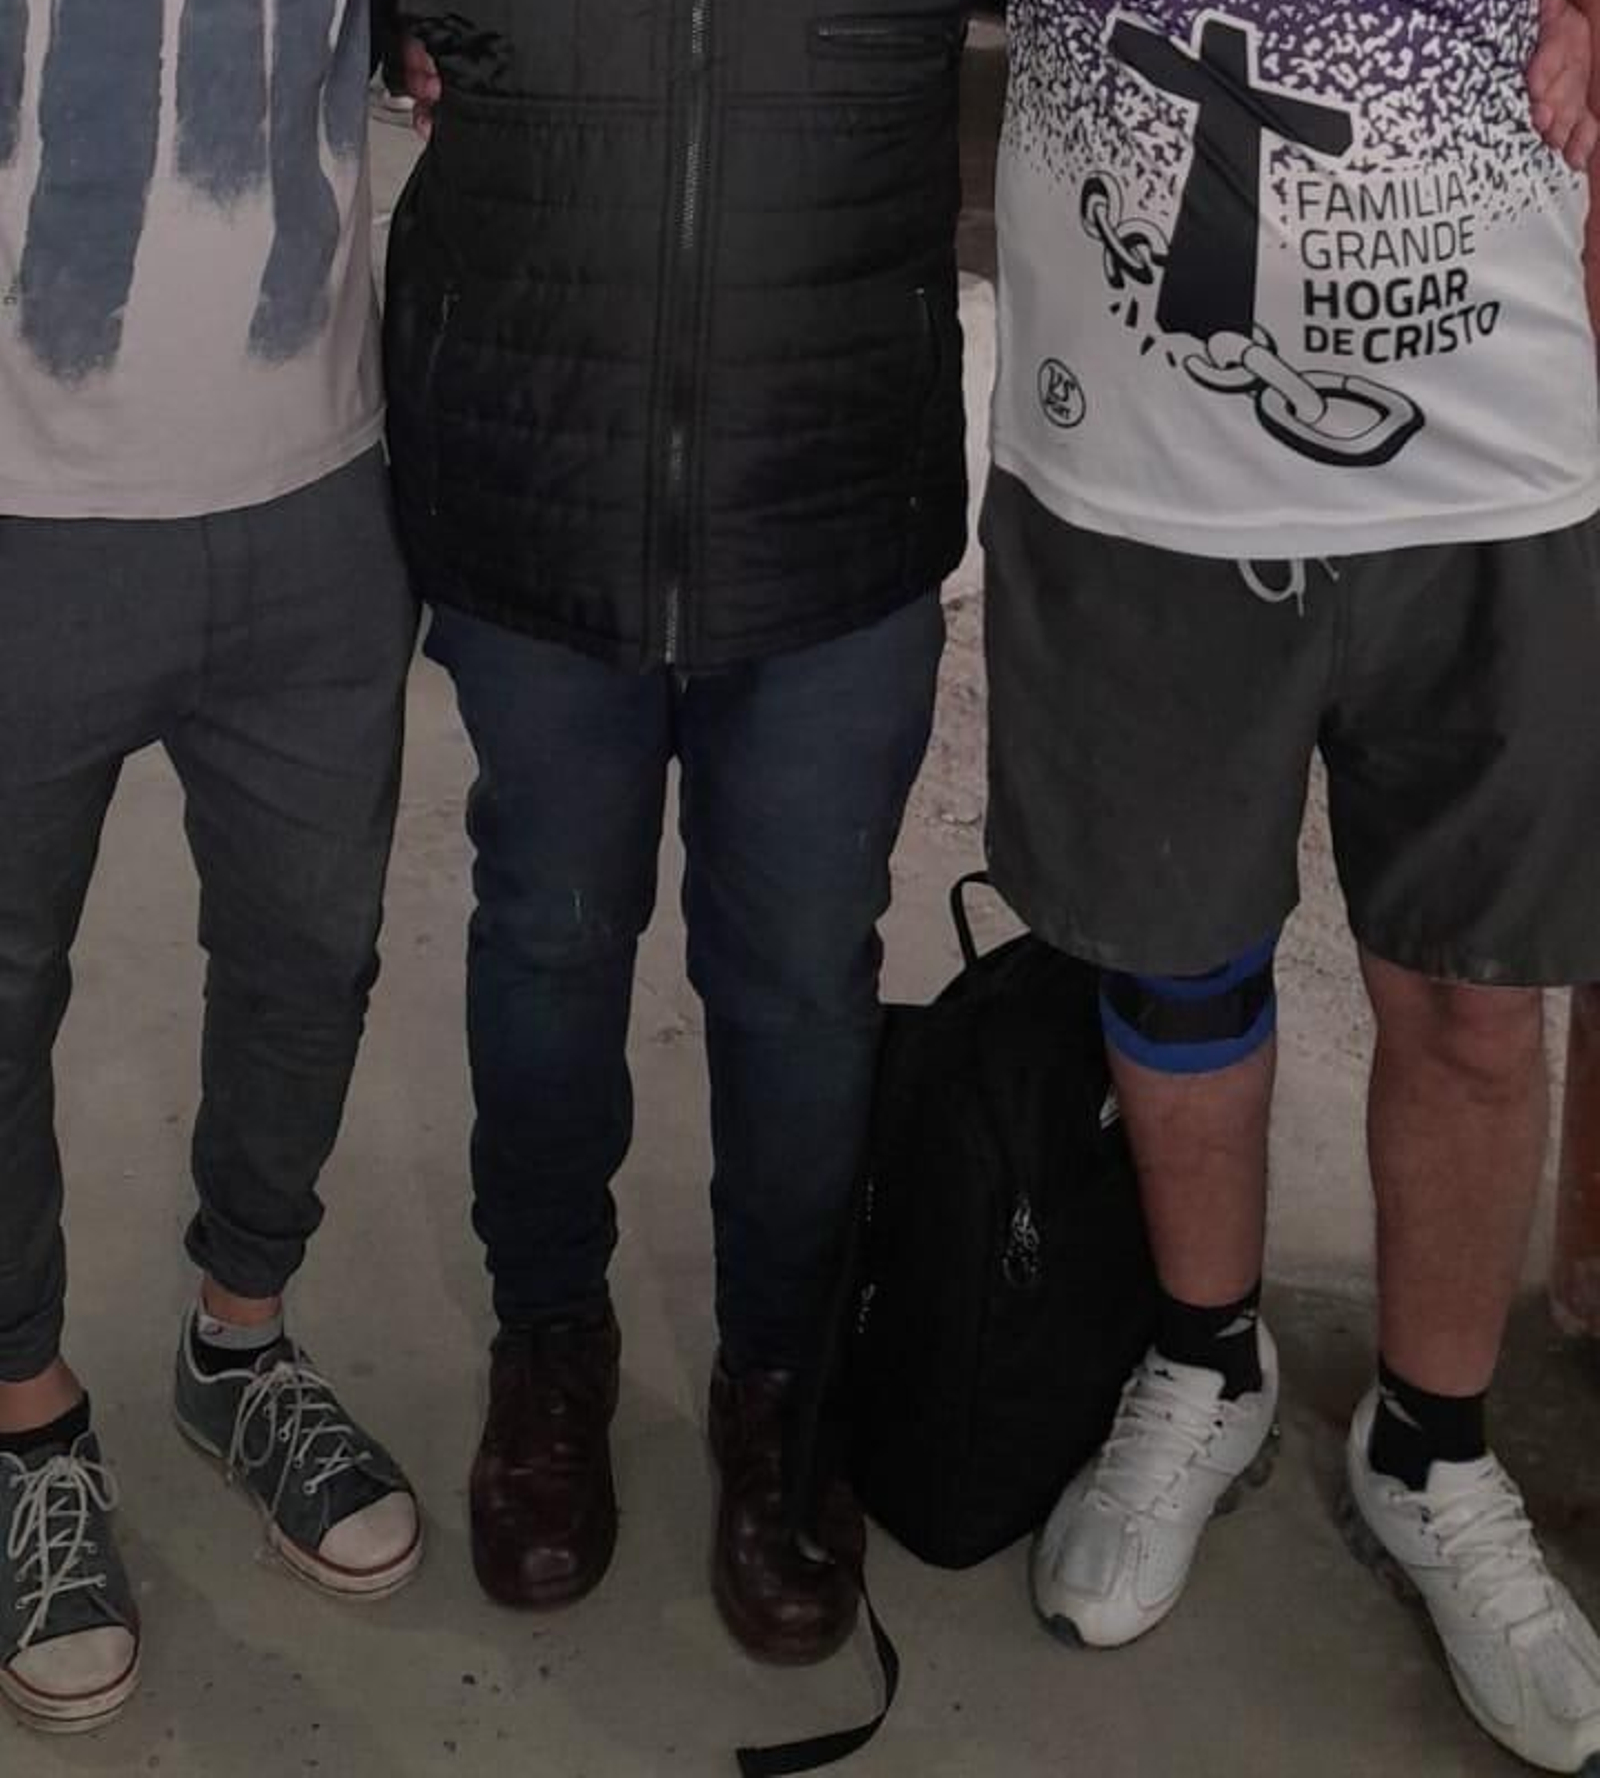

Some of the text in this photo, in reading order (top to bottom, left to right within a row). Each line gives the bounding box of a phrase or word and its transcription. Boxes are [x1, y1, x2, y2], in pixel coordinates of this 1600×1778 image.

[1297, 171, 1467, 221] FAMILIA
[1301, 215, 1476, 270] GRANDE
[1304, 267, 1468, 320] HOGAR
[1305, 301, 1500, 363] DE CRISTO
